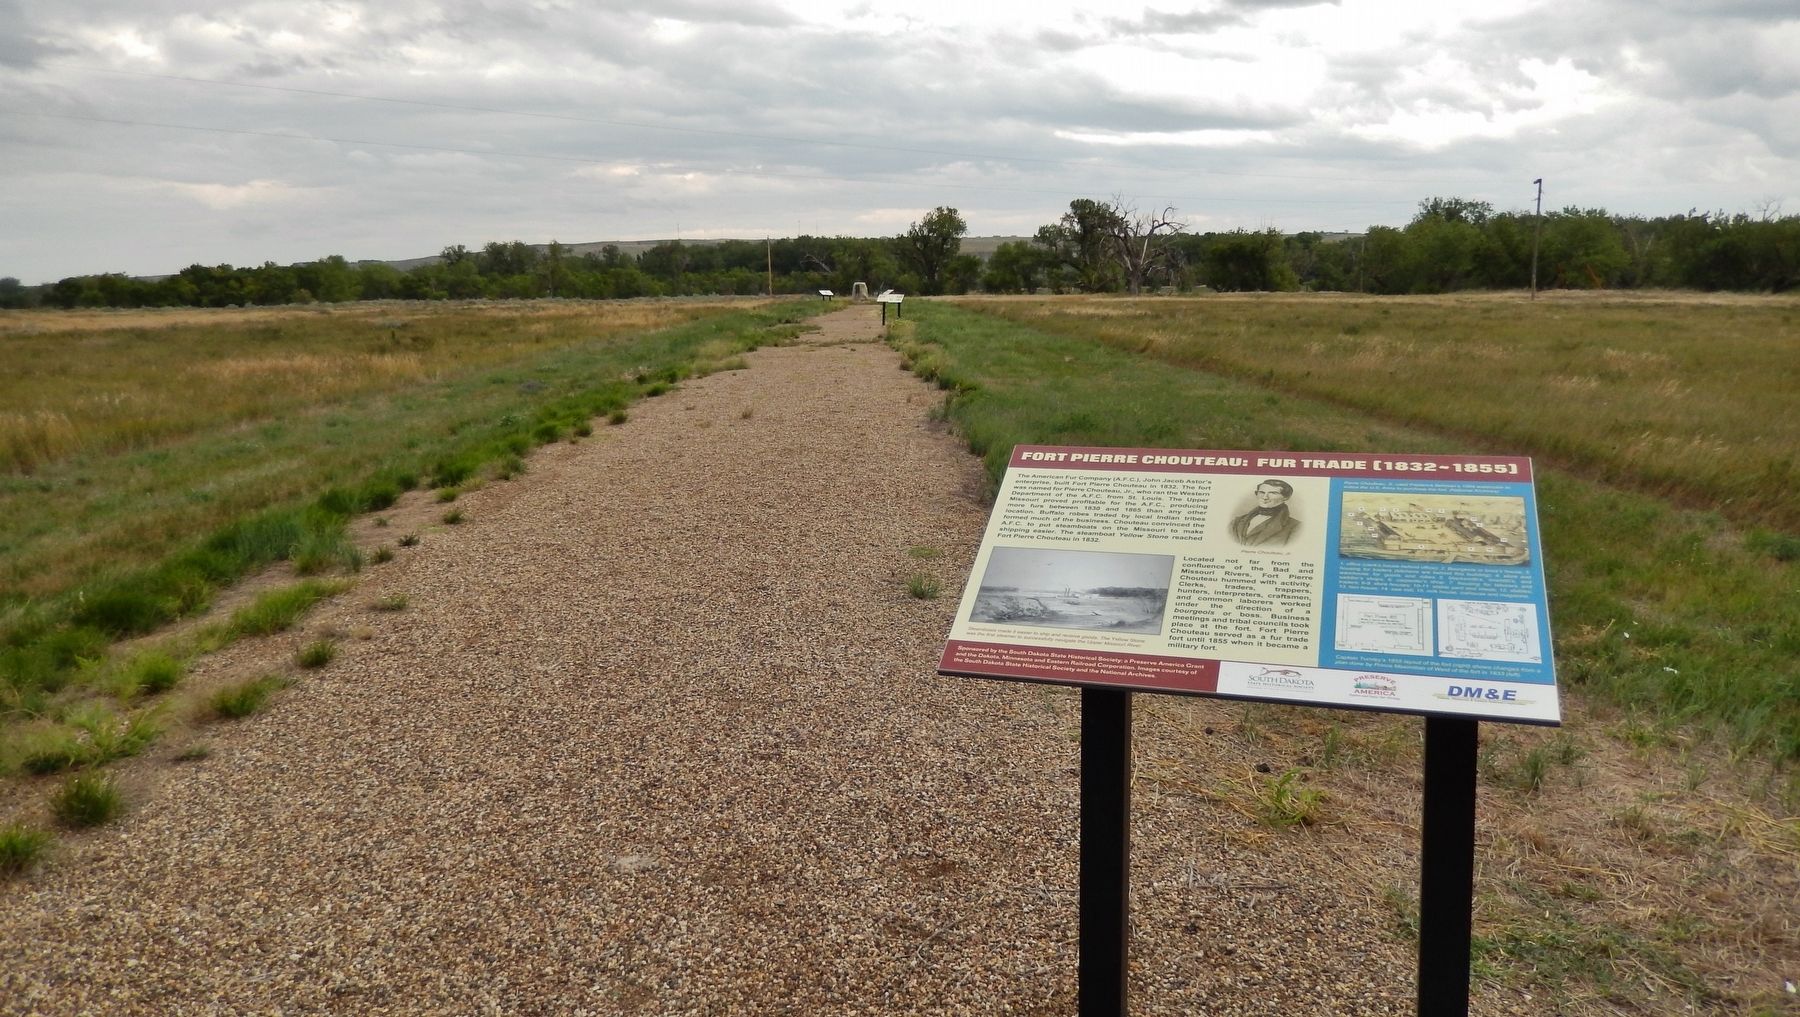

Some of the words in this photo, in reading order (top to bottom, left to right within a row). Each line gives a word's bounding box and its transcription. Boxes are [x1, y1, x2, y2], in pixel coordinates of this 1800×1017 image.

[1020, 451, 1068, 461] FORT
[1070, 453, 1138, 463] PIERRE
[1141, 454, 1248, 466] CHOUTEAU:
[1256, 458, 1296, 468] FUR
[1300, 459, 1366, 469] TRADE
[1224, 583, 1255, 591] traders,
[1274, 586, 1312, 594] trappers,
[1280, 580, 1312, 588] activity.
[1177, 587, 1210, 595] hunters,
[1213, 589, 1263, 598] interpreters,
[1267, 593, 1311, 601] craftsmen,
[1239, 597, 1273, 605] laborers
[1235, 604, 1272, 612] direction
[1173, 607, 1215, 615] bourgeois
[1270, 613, 1310, 621] Business
[1169, 627, 1209, 635] Chouteau
[1167, 642, 1198, 650] military
[1265, 641, 1299, 649] became
[1001, 654, 1033, 662] Minnesota
[1096, 662, 1136, 670] Corporation.
[1051, 664, 1075, 672] Society
[1248, 675, 1278, 684] SOUTH
[1279, 677, 1315, 687] DAKOTA
[1354, 674, 1395, 685] PRESERVE
[1354, 689, 1396, 697] AMERICA
[1447, 685, 1518, 701] DM&E
